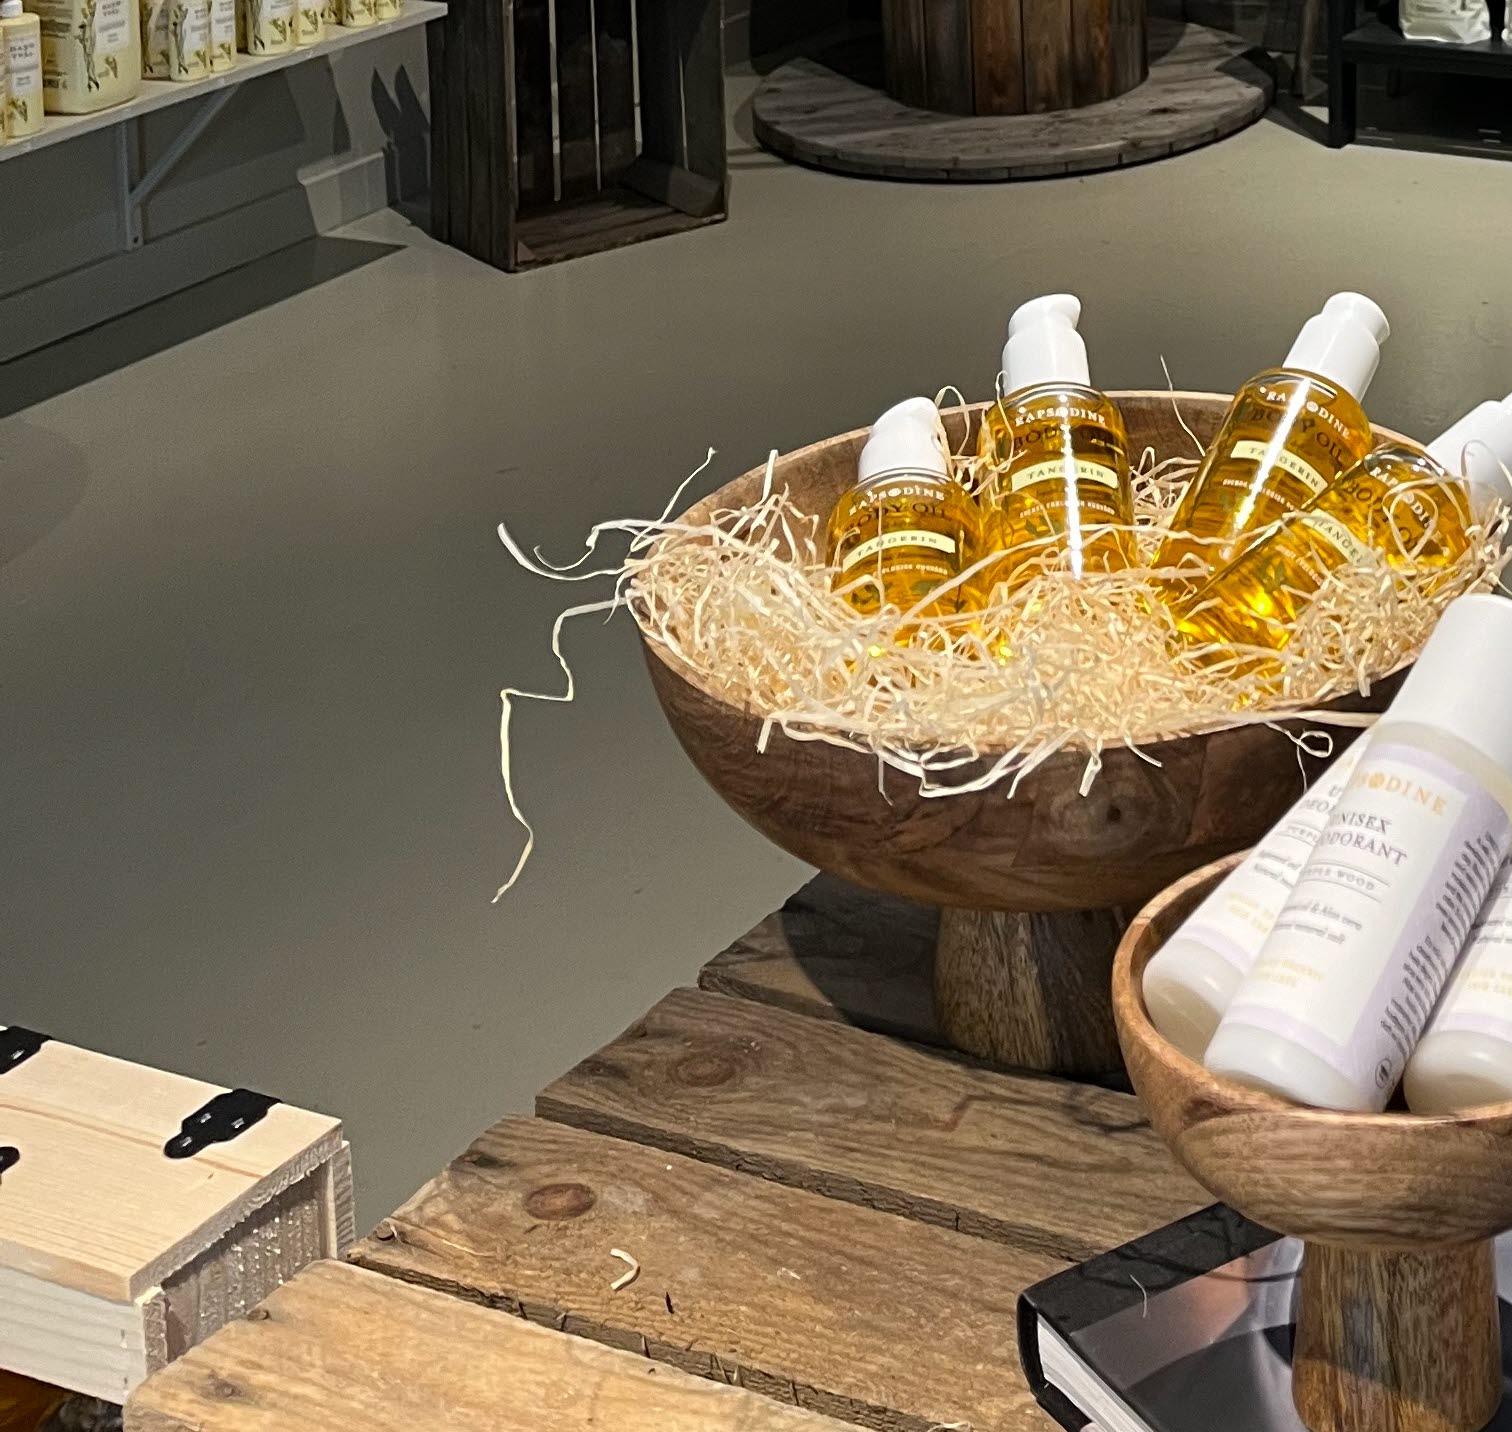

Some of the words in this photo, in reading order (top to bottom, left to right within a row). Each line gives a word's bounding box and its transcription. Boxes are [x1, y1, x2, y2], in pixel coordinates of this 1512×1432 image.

[1266, 390, 1350, 440] RAODINE
[1027, 466, 1104, 479] TANRIN
[1250, 446, 1319, 488] TAGERIN
